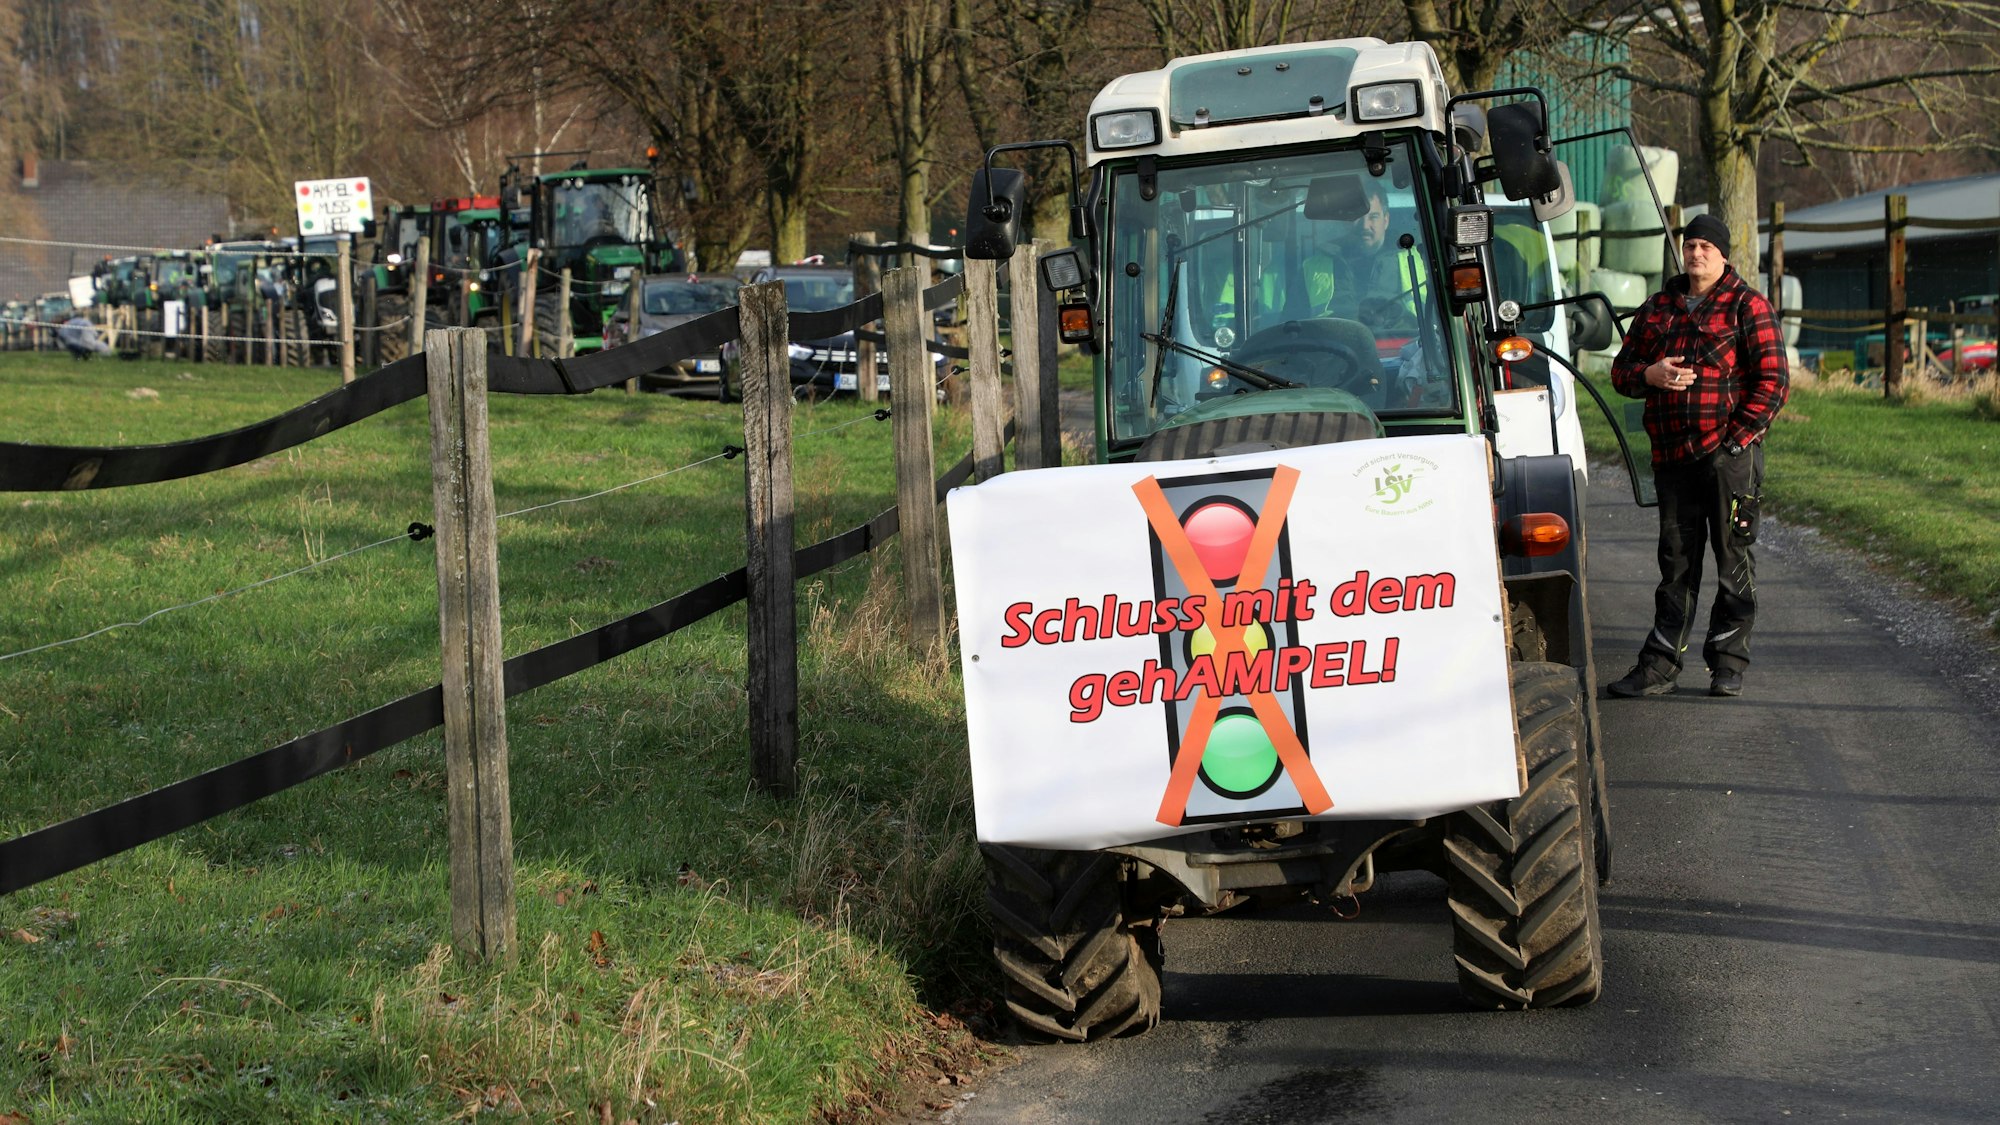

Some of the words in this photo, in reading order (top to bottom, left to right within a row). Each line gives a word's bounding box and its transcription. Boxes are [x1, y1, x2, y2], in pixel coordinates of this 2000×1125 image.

[313, 183, 352, 198] AMPEL
[319, 200, 351, 214] MUSS
[324, 216, 349, 234] WEG
[1352, 461, 1370, 478] Land
[1370, 453, 1396, 465] sichert
[1397, 453, 1440, 471] Versorgung
[1374, 474, 1413, 504] LSV
[1381, 508, 1405, 516] Bauern
[1001, 594, 1206, 648] Schluss
[1221, 578, 1317, 628] mit
[1330, 570, 1456, 618] dem
[1069, 637, 1400, 723] gehAMPEL!
